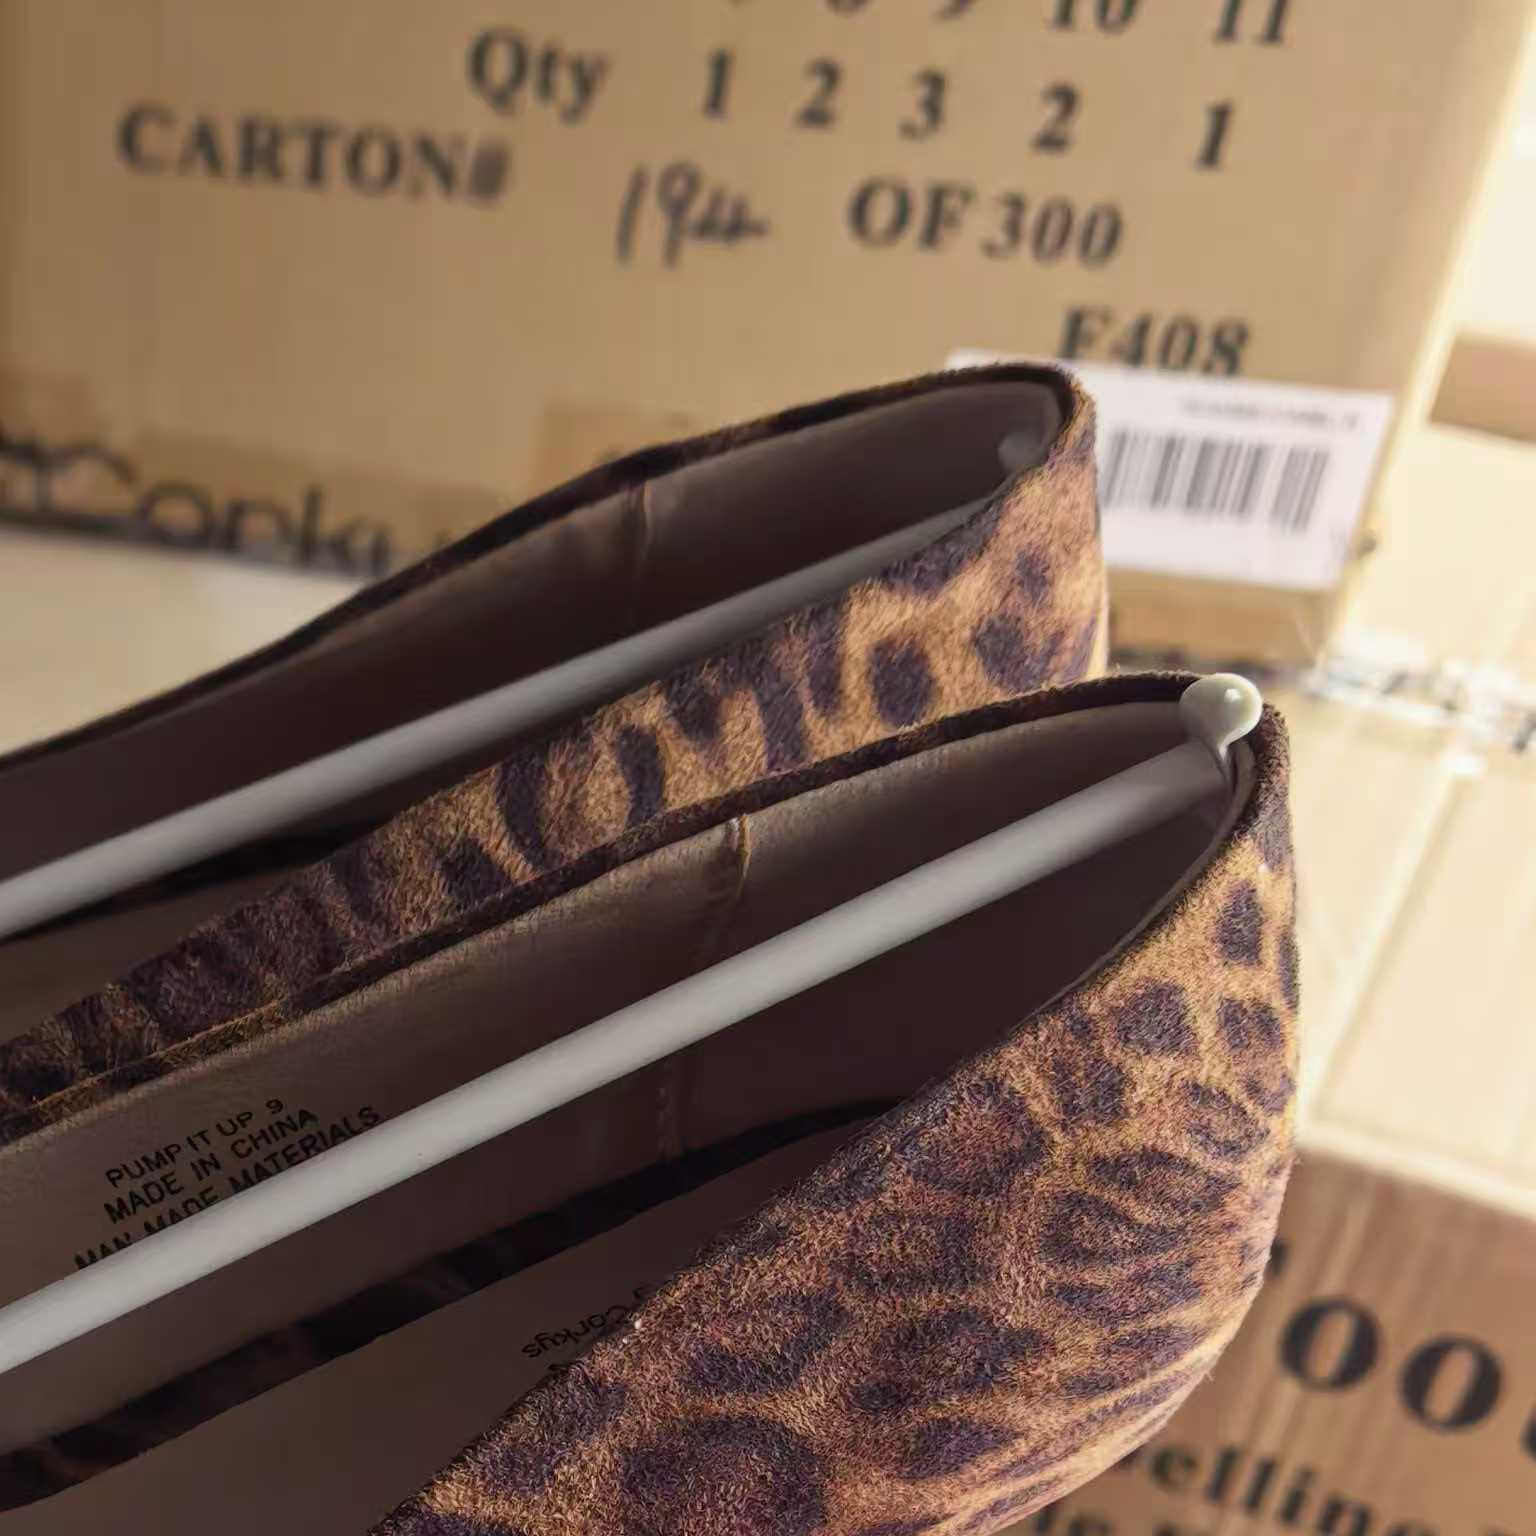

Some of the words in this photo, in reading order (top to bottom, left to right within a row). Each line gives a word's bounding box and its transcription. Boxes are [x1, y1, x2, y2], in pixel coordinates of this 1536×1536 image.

[468, 28, 611, 124] Qty
[704, 47, 734, 119] 1
[797, 59, 842, 130] 2
[900, 70, 947, 141] 3
[1033, 84, 1079, 154] 2
[1196, 99, 1232, 172] 1
[104, 1172, 185, 1225] MADE
[191, 1153, 222, 1182] IN
[229, 1108, 320, 1160] CHINA
[105, 1143, 183, 1187] PUMP
[186, 1129, 211, 1152] IT
[216, 1110, 254, 1137] UP
[265, 1098, 285, 1115] 9
[228, 1105, 382, 1195] MATERIALS
